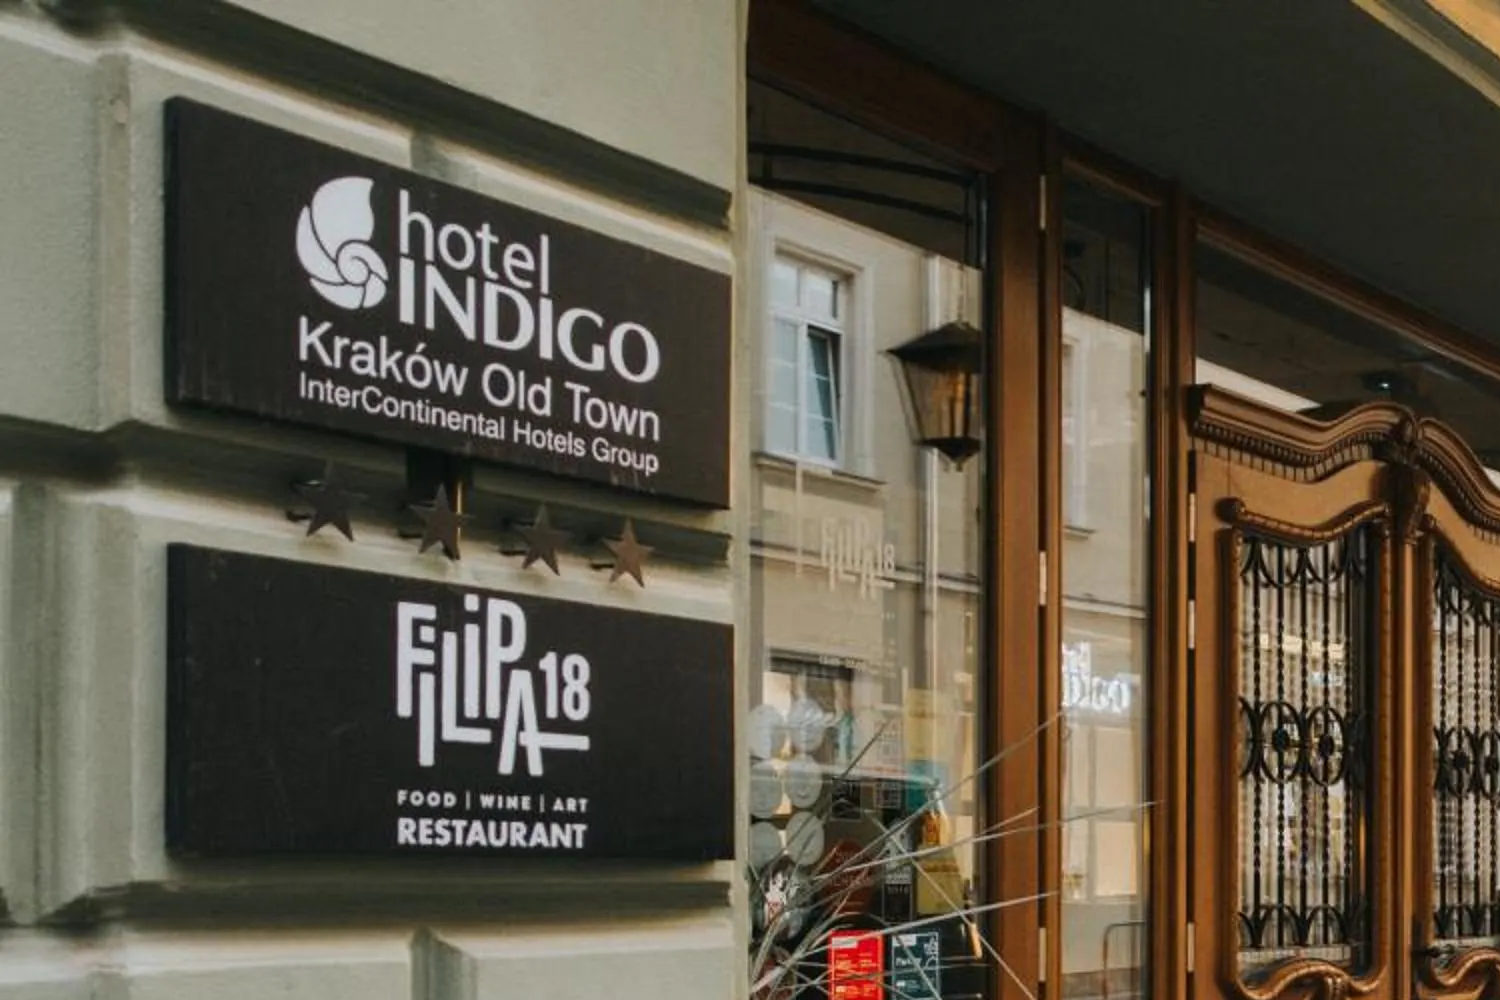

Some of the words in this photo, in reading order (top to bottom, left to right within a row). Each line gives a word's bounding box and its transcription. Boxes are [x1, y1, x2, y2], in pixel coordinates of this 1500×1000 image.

[399, 189, 549, 296] hotel
[399, 256, 660, 383] INDIGO
[299, 315, 469, 397] Kraków
[482, 363, 552, 417] Old
[564, 381, 660, 442] Town
[299, 371, 505, 440] InterContinental
[513, 419, 586, 458] Hotels
[591, 437, 660, 474] Group
[538, 651, 591, 722] 18
[397, 789, 457, 809] FOOD
[480, 793, 532, 812] WINE
[553, 797, 588, 815] ART
[397, 817, 588, 849] RESTAURANT
